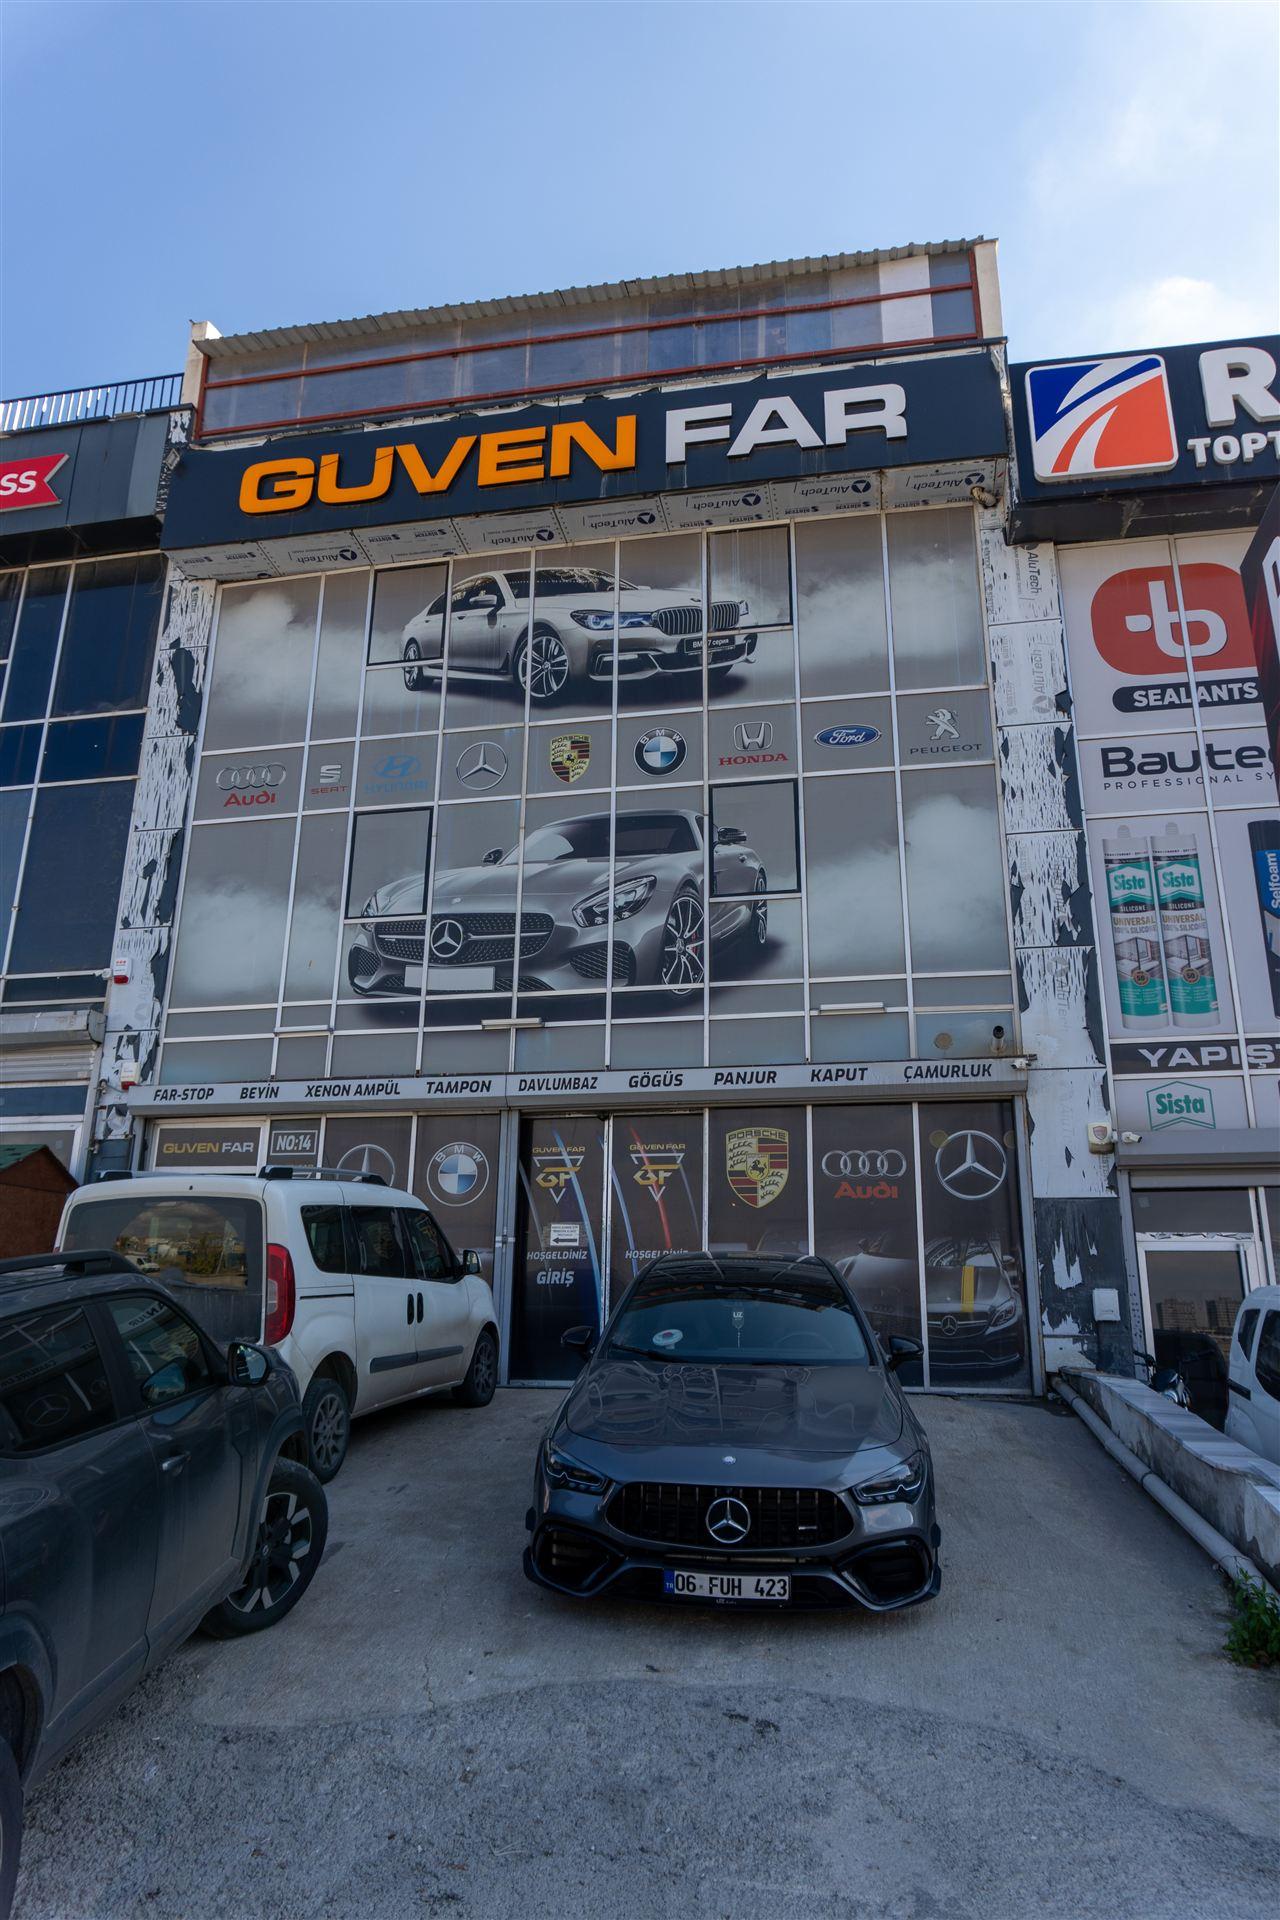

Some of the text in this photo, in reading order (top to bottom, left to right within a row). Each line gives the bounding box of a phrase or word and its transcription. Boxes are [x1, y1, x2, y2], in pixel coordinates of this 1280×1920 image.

[239, 383, 909, 516] GUVEN FAR
[801, 485, 850, 496] AluTech
[913, 479, 963, 491] AluTech
[693, 498, 740, 510] AluTech
[590, 516, 636, 529] AluTech
[490, 534, 535, 545] AluTech
[297, 551, 340, 563] AluTech
[1027, 551, 1042, 594] AluTech
[1133, 682, 1259, 707] SEALANTS
[640, 729, 682, 745] BMW
[829, 728, 866, 745] Ford
[910, 743, 983, 755] PEUGEOT
[718, 752, 789, 766] HONDA
[1101, 743, 1274, 778] Baute
[311, 785, 348, 795] SEAT
[364, 779, 429, 795] HYUNDAI
[1104, 774, 1243, 791] PROFESSIONAL
[223, 790, 276, 808] Audi
[1113, 874, 1146, 890] Sista
[1162, 871, 1194, 888] Sista
[1113, 915, 1157, 926] UNIVERSAL
[1162, 913, 1206, 924] UNIVERSAL
[1138, 1045, 1280, 1069] YAPIŞ
[153, 1086, 214, 1101] FAR-STOP
[239, 1082, 279, 1099] BEYİN
[304, 1083, 351, 1098] XENON
[353, 1079, 401, 1096] AMPÜL
[426, 1079, 492, 1095] TAMPON
[518, 1076, 598, 1092] DAVLUMBAZ
[713, 1069, 778, 1086] PANJUR
[810, 1067, 869, 1082] KAPUT
[903, 1063, 993, 1082] ÇAMURLUK
[1155, 1093, 1206, 1115] Sista
[276, 1134, 311, 1151] NO:14
[728, 1129, 787, 1141] PORSCHE
[163, 1141, 254, 1154] GUVEN FAR
[435, 1145, 484, 1162] BMW
[833, 1182, 899, 1199] Audi
[527, 1249, 588, 1260] HOŞGELDİNİZ
[536, 1268, 575, 1287] GİRİŞ
[675, 1573, 788, 1598] 06 FUH 423
